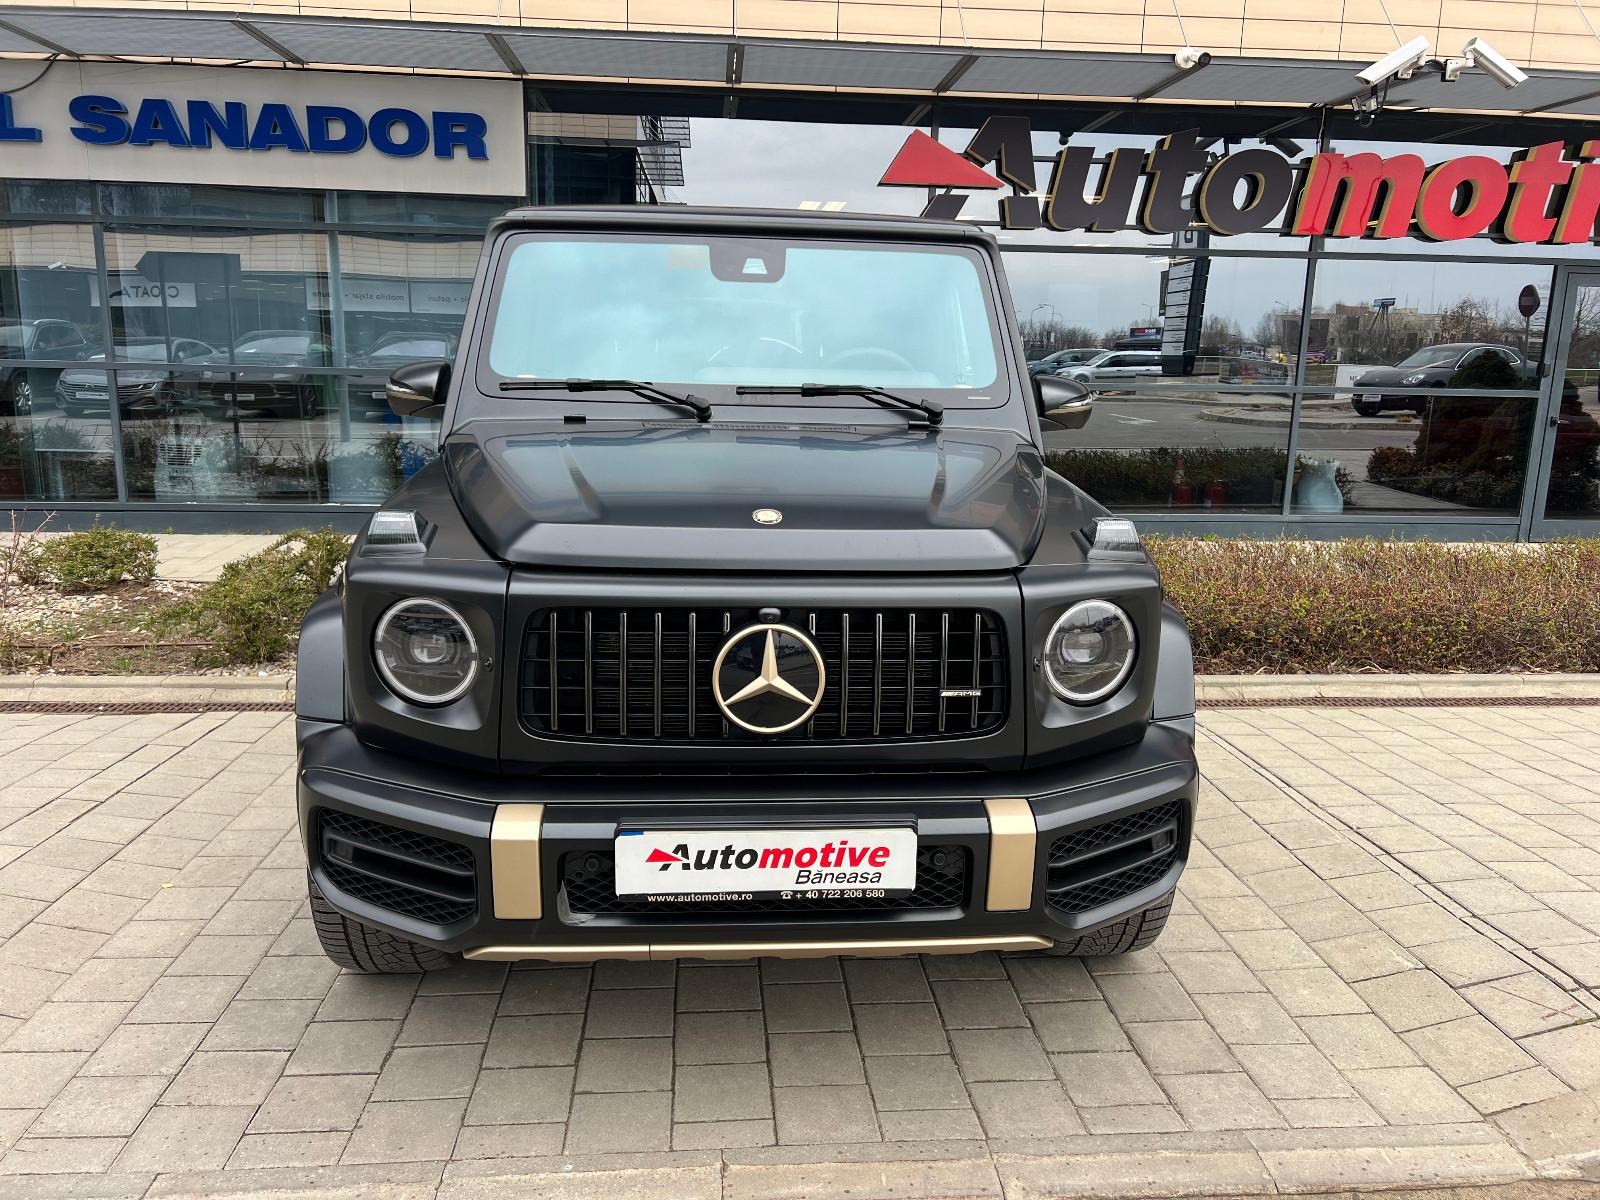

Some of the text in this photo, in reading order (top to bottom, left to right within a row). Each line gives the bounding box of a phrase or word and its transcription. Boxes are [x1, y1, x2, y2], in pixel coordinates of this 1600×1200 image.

[69, 94, 489, 161] SANADOR
[920, 115, 1600, 244] Automoti
[657, 840, 890, 871] Automotive
[795, 869, 882, 884] Băneasa
[647, 893, 753, 902] www.automotive.ro
[805, 890, 819, 899] 40
[822, 890, 841, 899] 722
[843, 889, 863, 898] 206
[865, 889, 885, 898] 580
